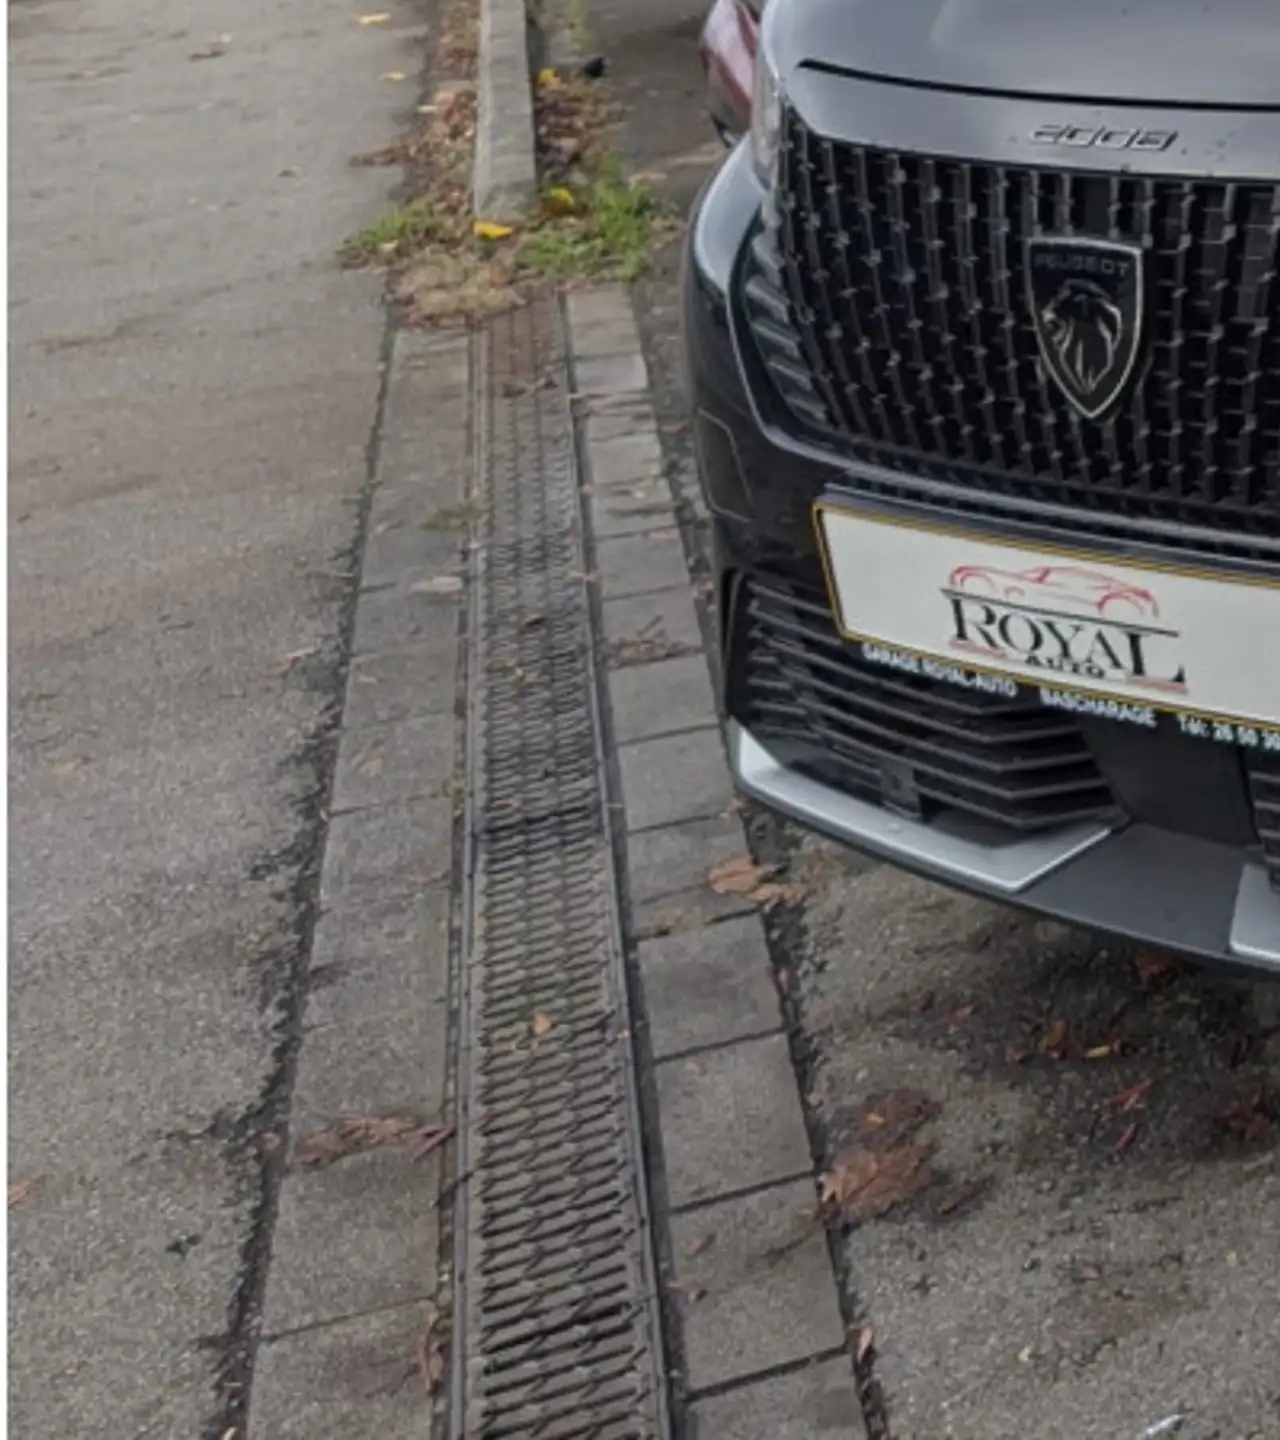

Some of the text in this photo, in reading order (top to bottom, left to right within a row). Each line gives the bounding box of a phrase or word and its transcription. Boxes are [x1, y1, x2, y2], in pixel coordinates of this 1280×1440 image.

[1033, 123, 1180, 152] 2008
[1033, 251, 1130, 278] PEUGEOT
[951, 596, 1187, 683] ROYAL
[1025, 654, 1107, 680] AUTO
[1039, 687, 1159, 729] BASCHARAGE
